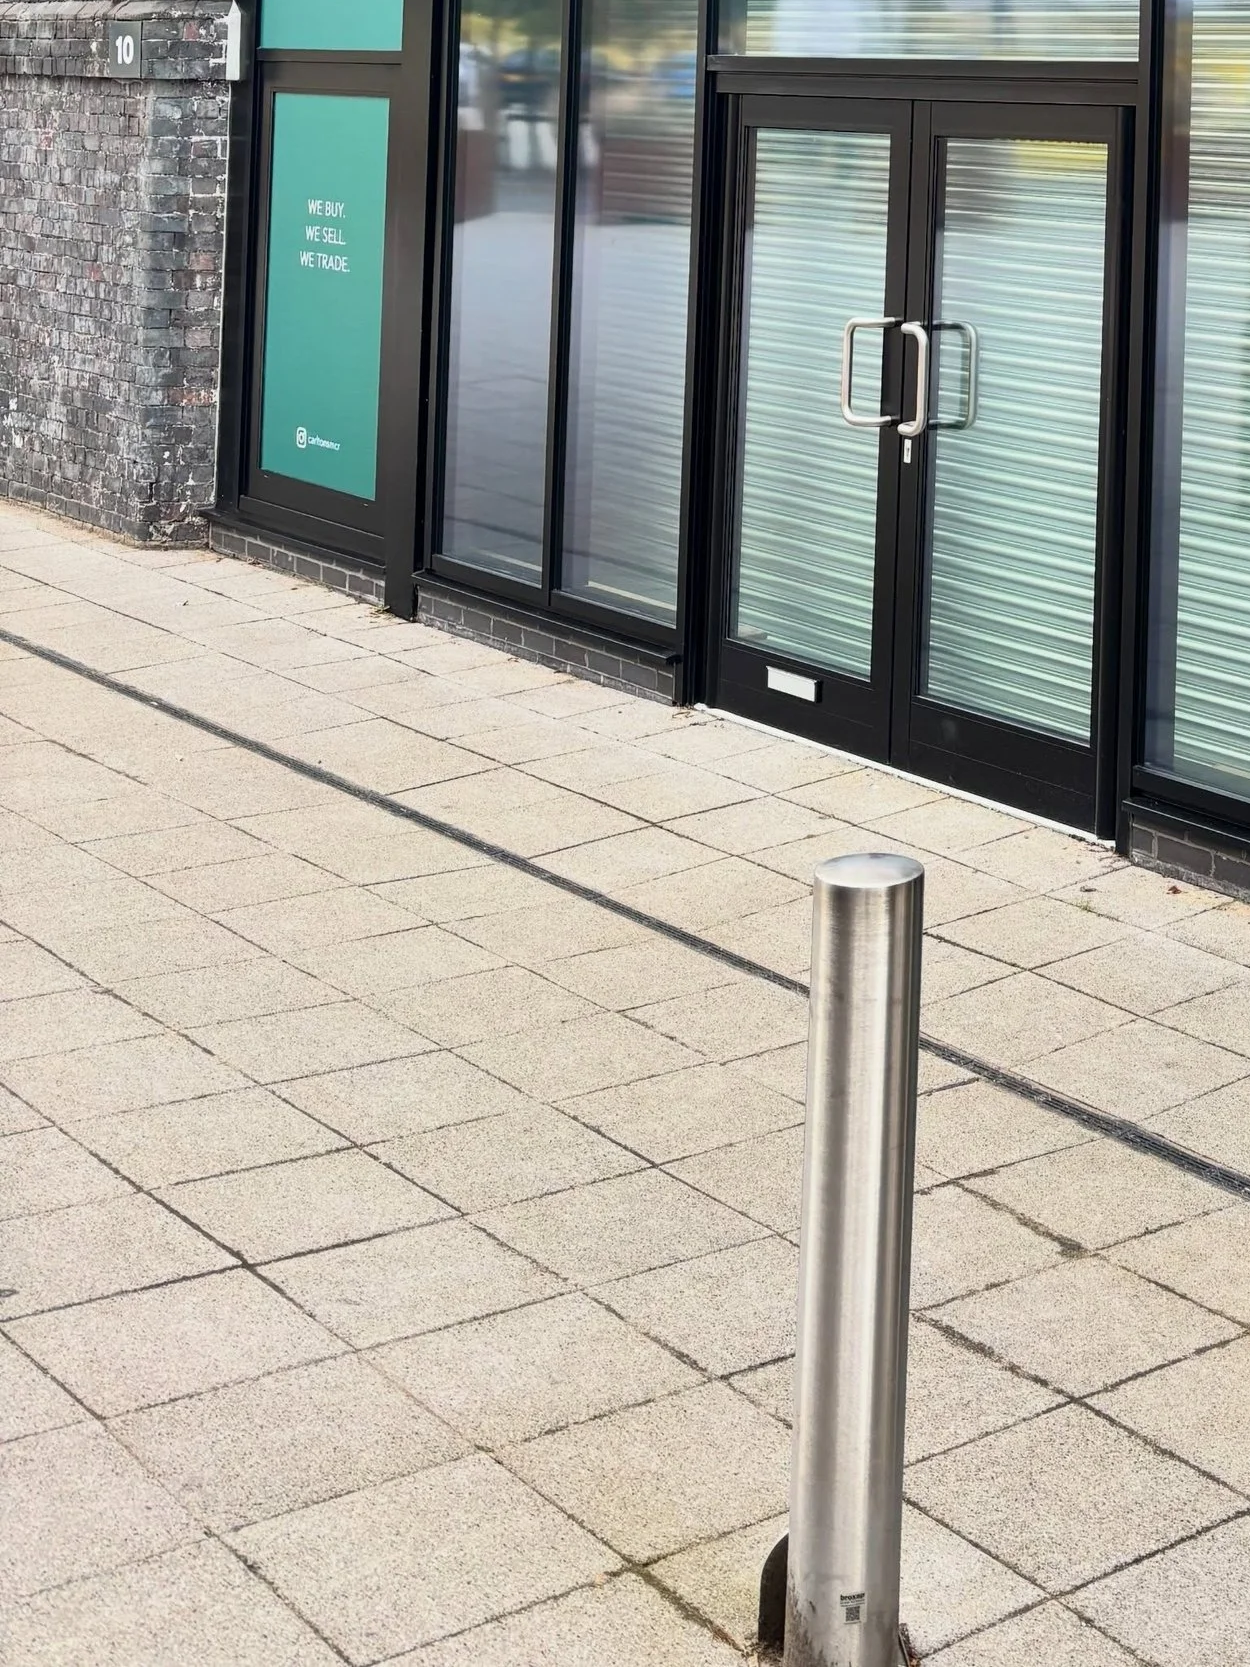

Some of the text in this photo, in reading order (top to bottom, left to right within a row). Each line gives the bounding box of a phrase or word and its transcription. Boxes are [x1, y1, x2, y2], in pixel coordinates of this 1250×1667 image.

[115, 35, 135, 65] 10
[307, 198, 346, 219] WE BUY.
[305, 225, 321, 242] WE
[299, 250, 351, 273] WE TRADE.
